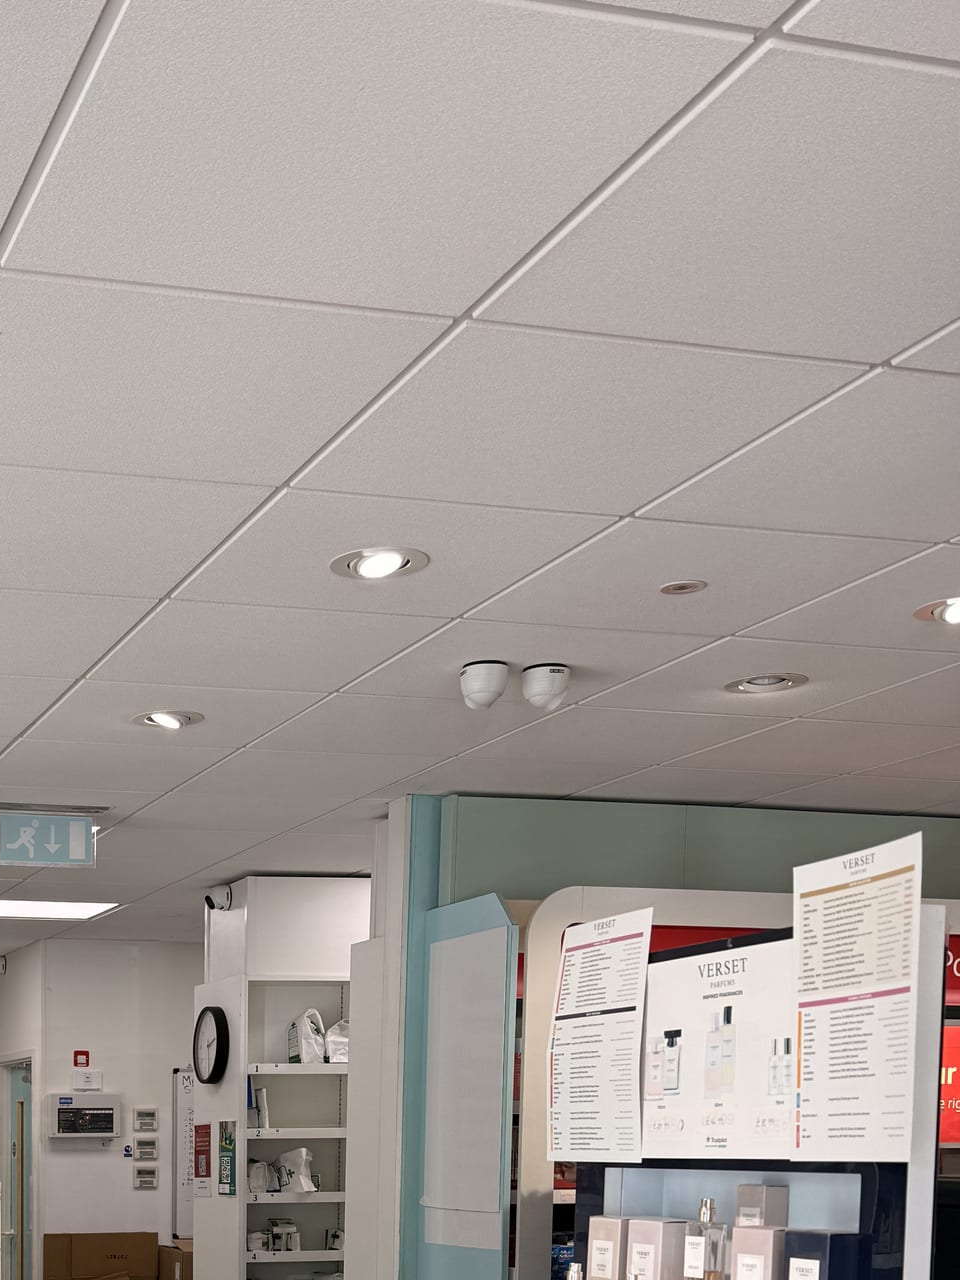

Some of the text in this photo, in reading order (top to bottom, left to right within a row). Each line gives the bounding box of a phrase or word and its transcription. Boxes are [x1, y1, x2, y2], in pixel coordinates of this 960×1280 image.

[842, 853, 876, 870] VERSET
[698, 957, 748, 979] VERSET
[710, 979, 735, 989] PARFUMS
[795, 1266, 813, 1274] VERSET
